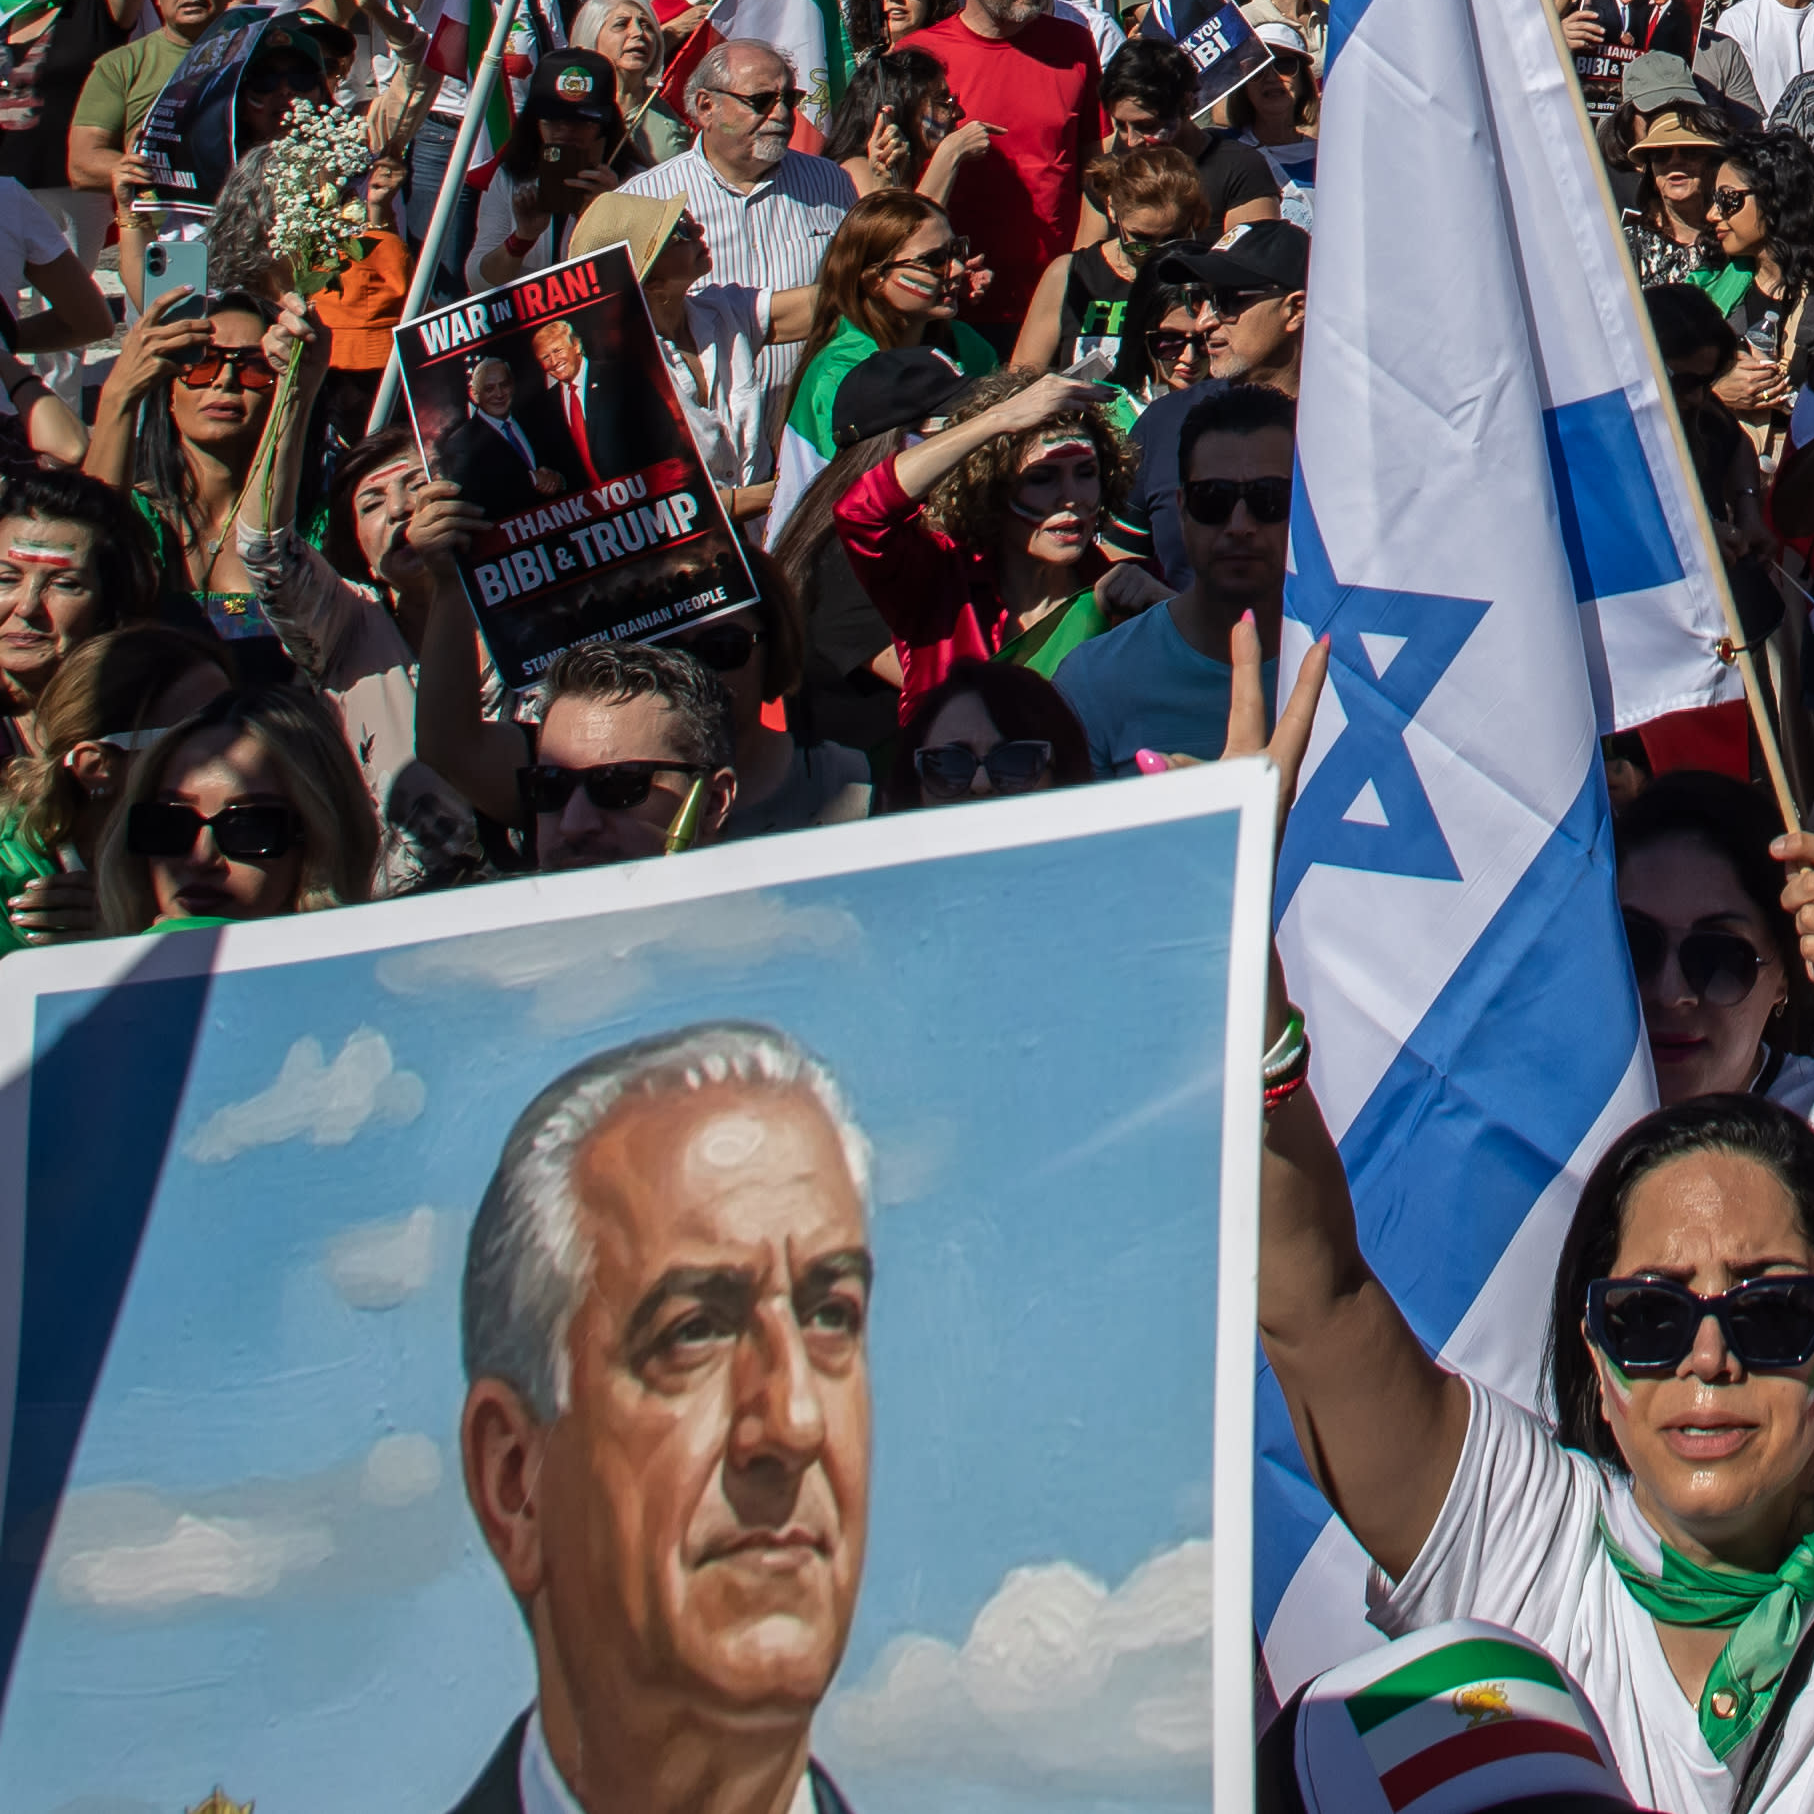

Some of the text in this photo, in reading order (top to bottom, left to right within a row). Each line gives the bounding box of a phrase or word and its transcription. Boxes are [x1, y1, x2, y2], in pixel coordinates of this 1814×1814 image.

[1194, 16, 1223, 44] YOU
[1597, 45, 1638, 62] THANK
[1576, 56, 1620, 77] BIBI &
[418, 262, 602, 356] WAR IN IRAN!
[500, 474, 648, 545] THANK YOU
[474, 492, 699, 608] BIBI & TRUMP
[611, 607, 673, 640] IRANIAN
[674, 585, 728, 619] PEOPLE
